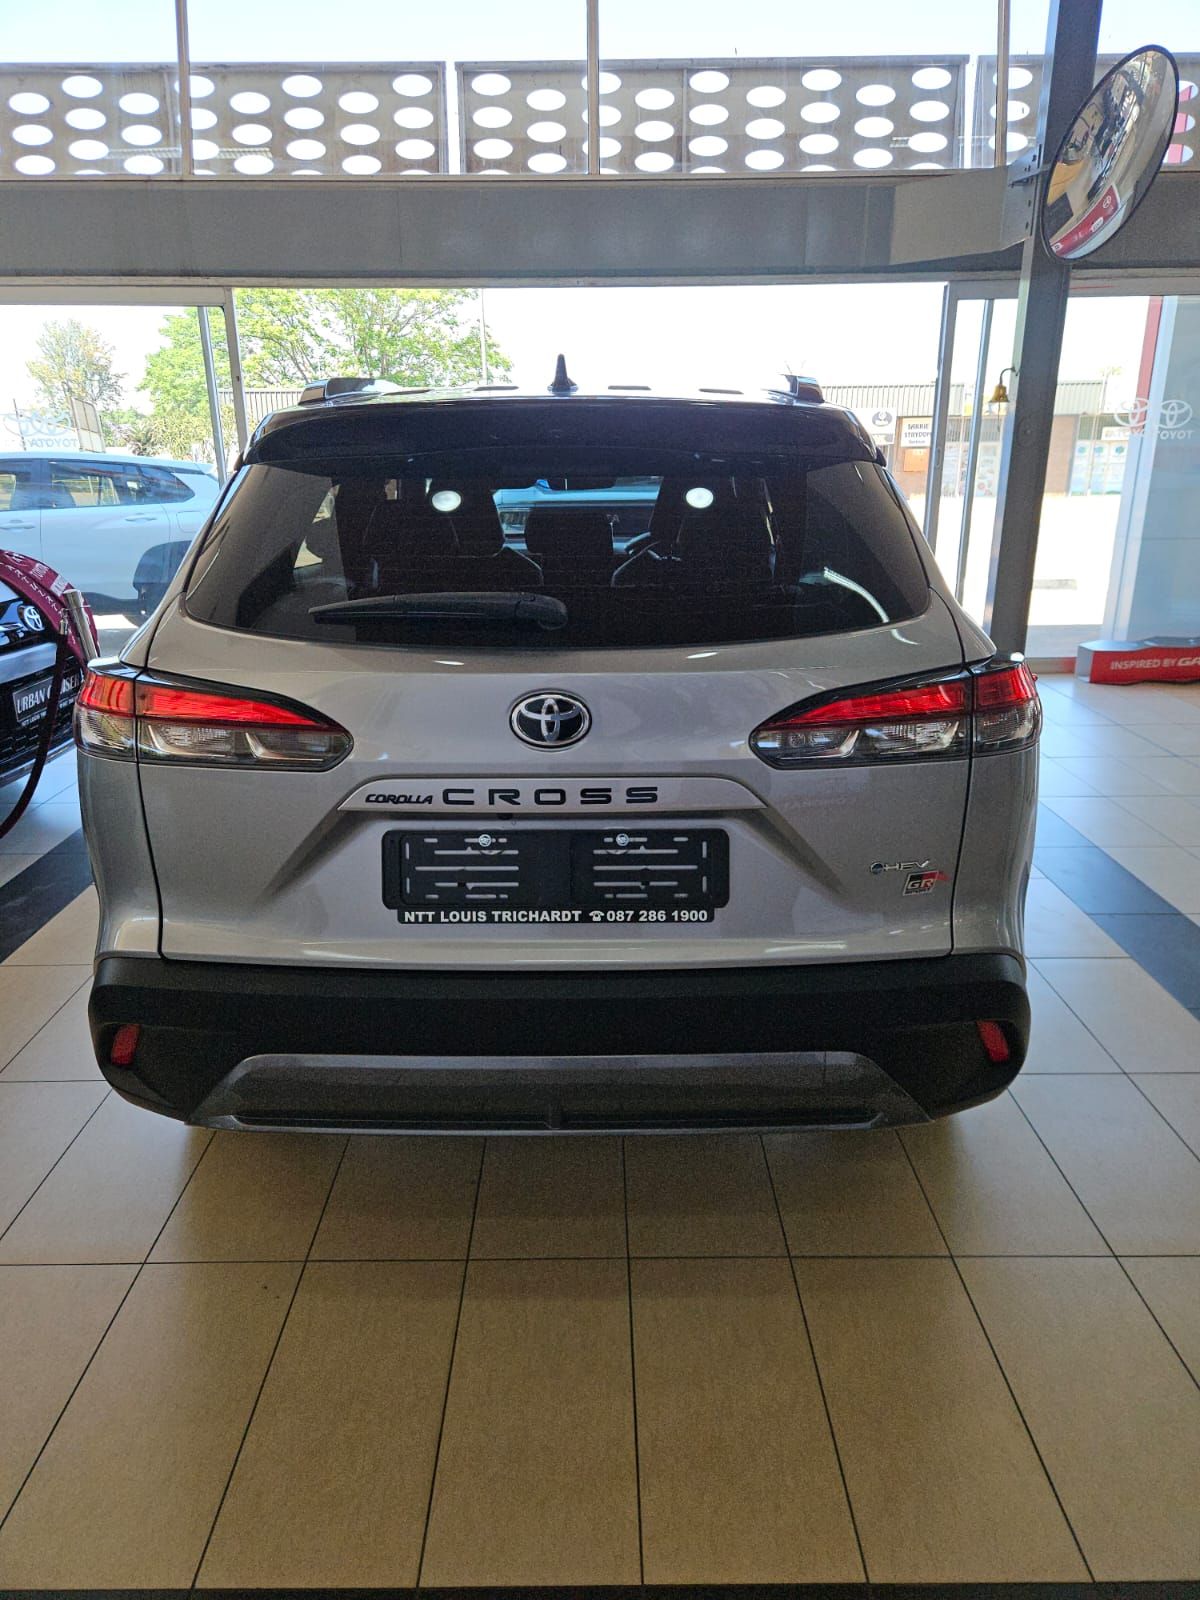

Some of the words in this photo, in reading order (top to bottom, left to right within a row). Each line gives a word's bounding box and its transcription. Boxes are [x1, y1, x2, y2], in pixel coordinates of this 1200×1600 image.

[1111, 660, 1160, 670] INSPIRED
[1163, 658, 1177, 667] BY
[17, 688, 46, 714] URBAN
[365, 794, 433, 804] COROLLA
[442, 787, 658, 805] CROSS
[908, 879, 934, 889] GR
[404, 911, 435, 922] NTT
[440, 911, 487, 922] LOUIS
[492, 910, 582, 922] TRICHARDT
[606, 910, 634, 921] 087
[638, 910, 667, 921] 286
[671, 910, 708, 921] 1900
